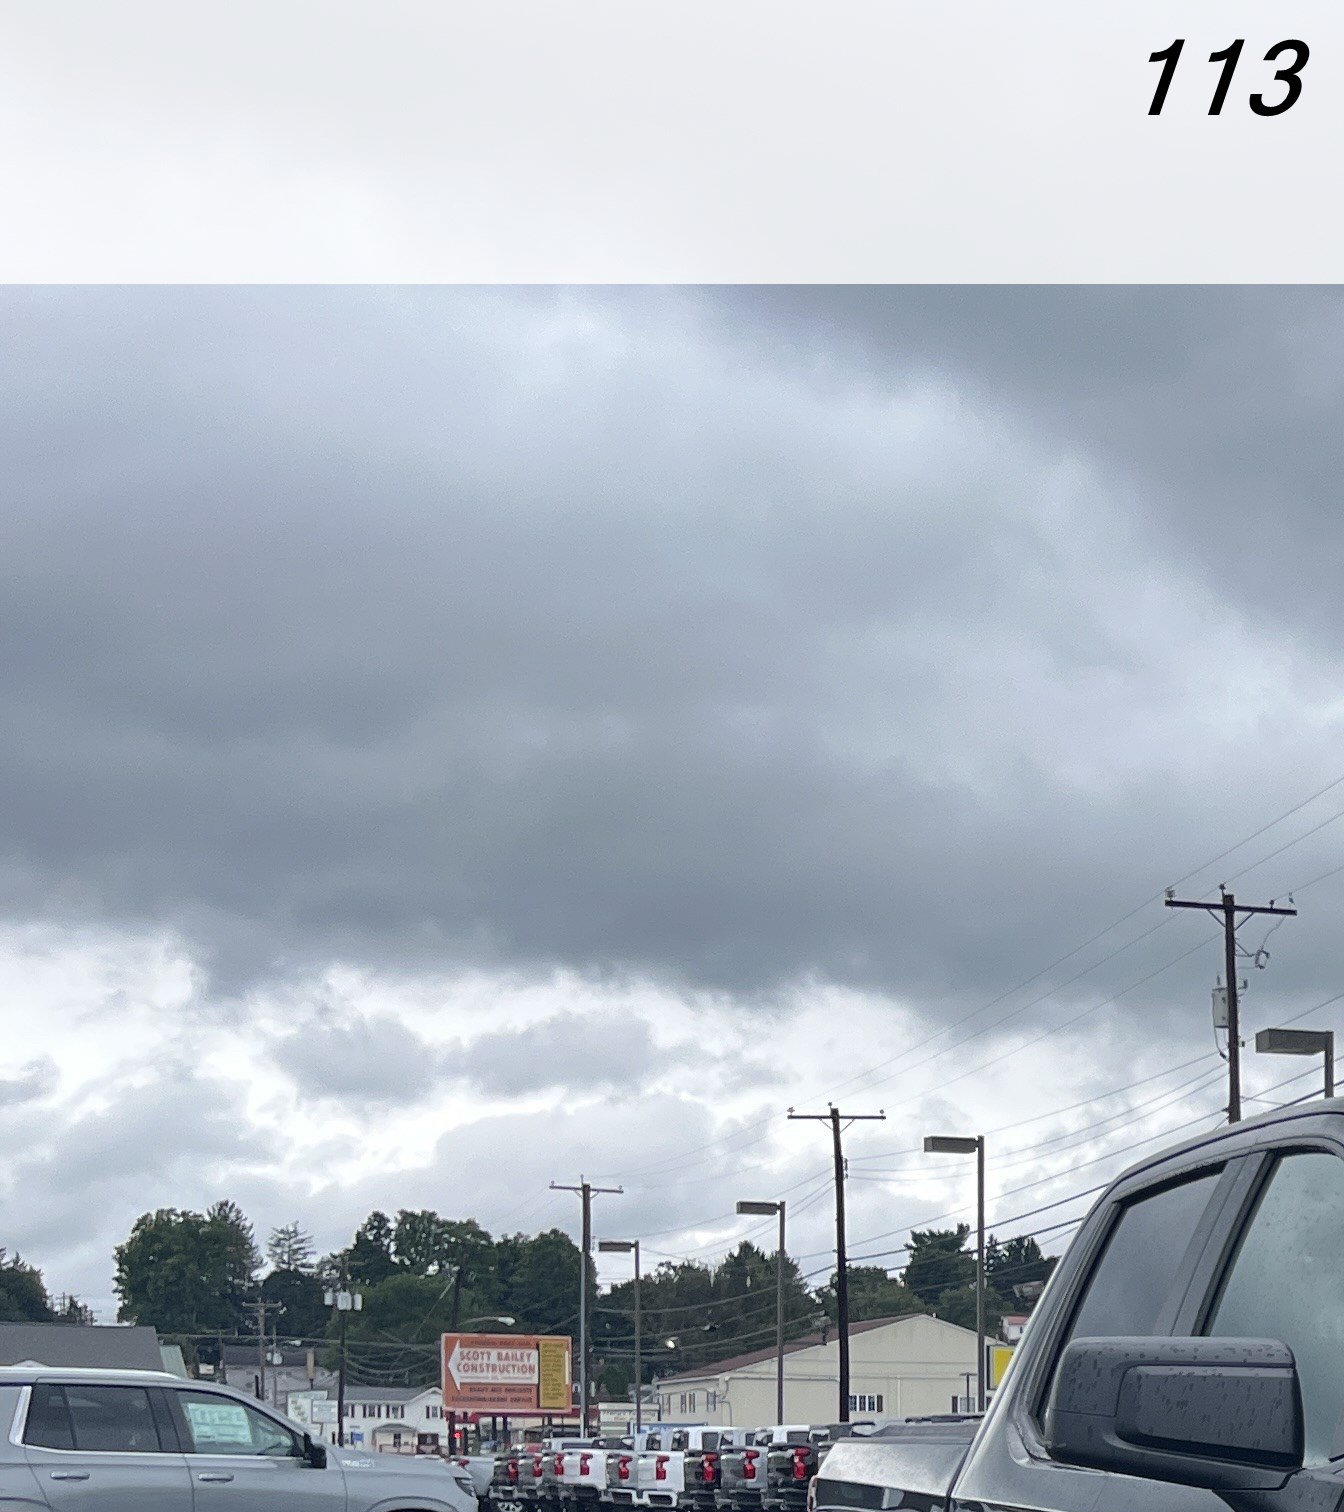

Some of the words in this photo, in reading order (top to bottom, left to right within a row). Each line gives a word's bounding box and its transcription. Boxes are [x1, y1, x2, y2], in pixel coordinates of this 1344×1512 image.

[459, 1349, 492, 1362] SCOTT
[496, 1350, 533, 1363] BAILEY
[456, 1362, 536, 1375] CONSTRUCTION
